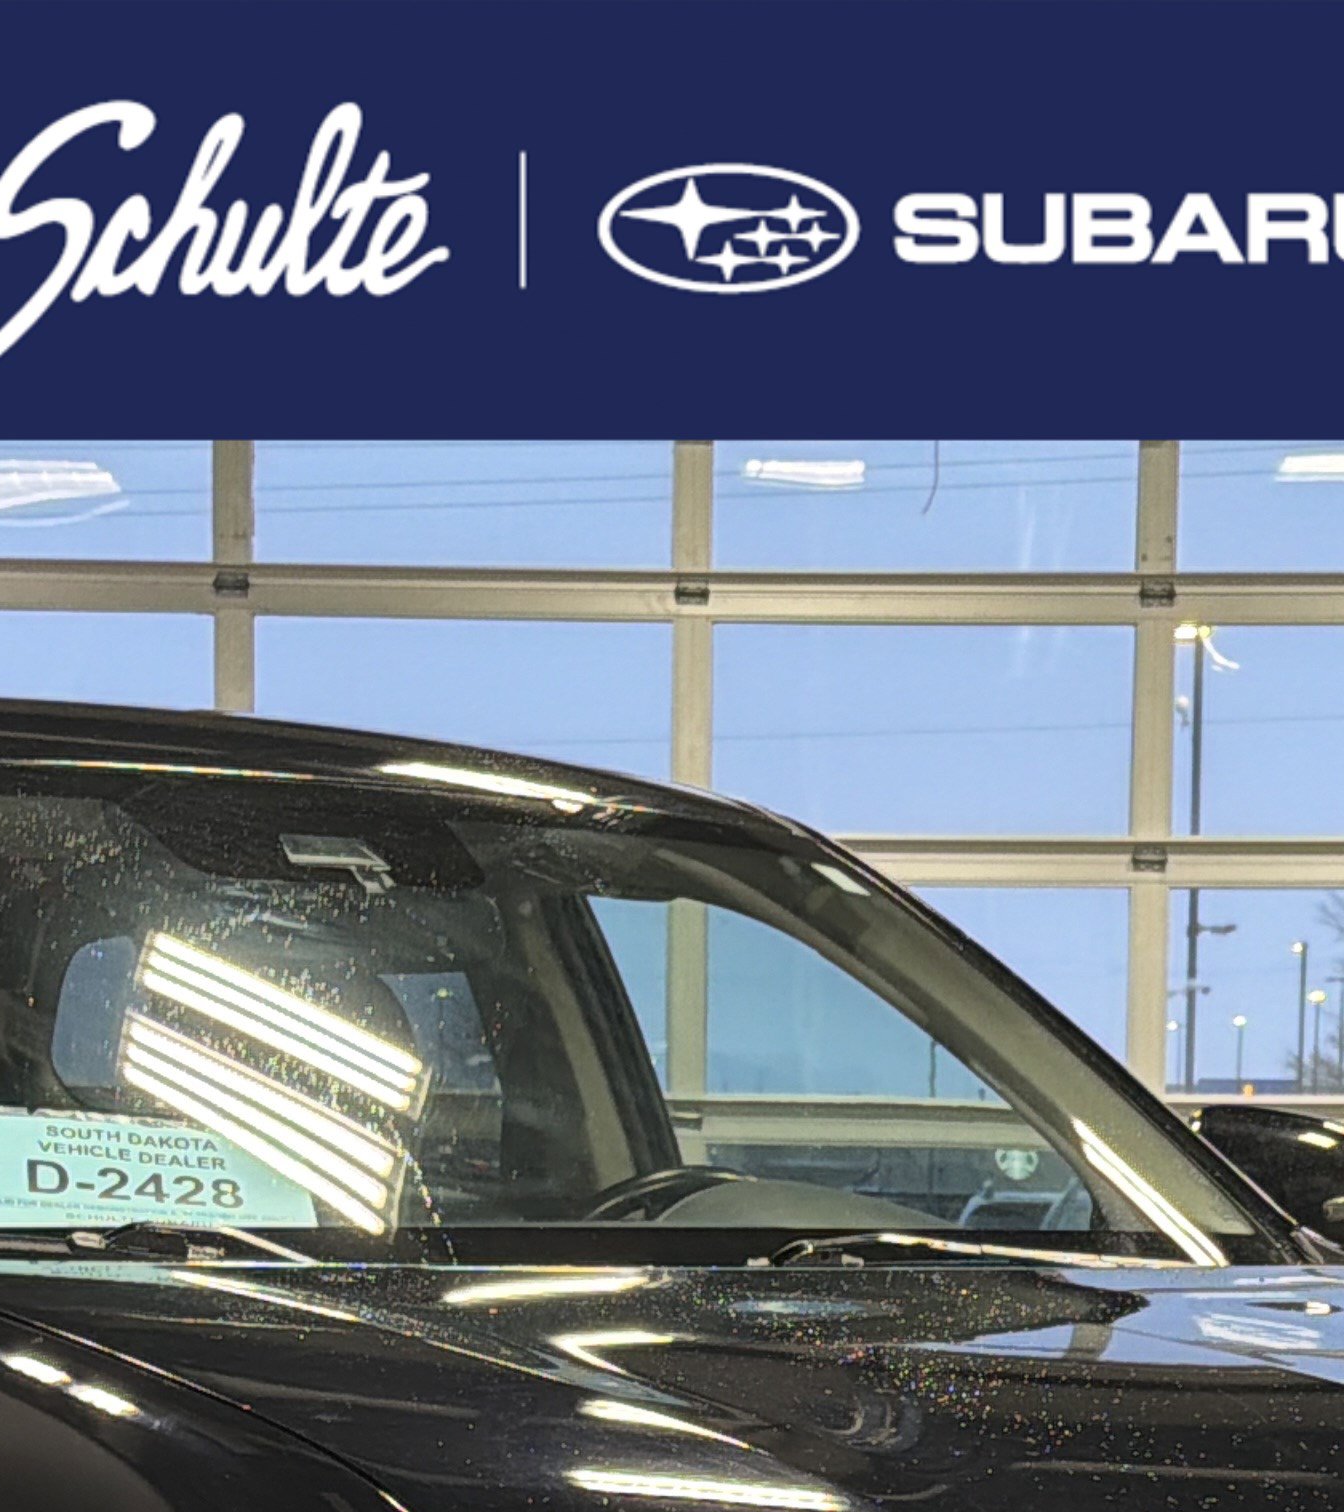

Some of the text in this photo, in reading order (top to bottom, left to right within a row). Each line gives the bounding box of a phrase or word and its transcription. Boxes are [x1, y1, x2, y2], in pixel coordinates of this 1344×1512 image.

[46, 1125, 218, 1152] SOUTH DAKOTA
[37, 1139, 227, 1171] VEHICLE DEALER
[27, 1159, 244, 1209] D-2428
